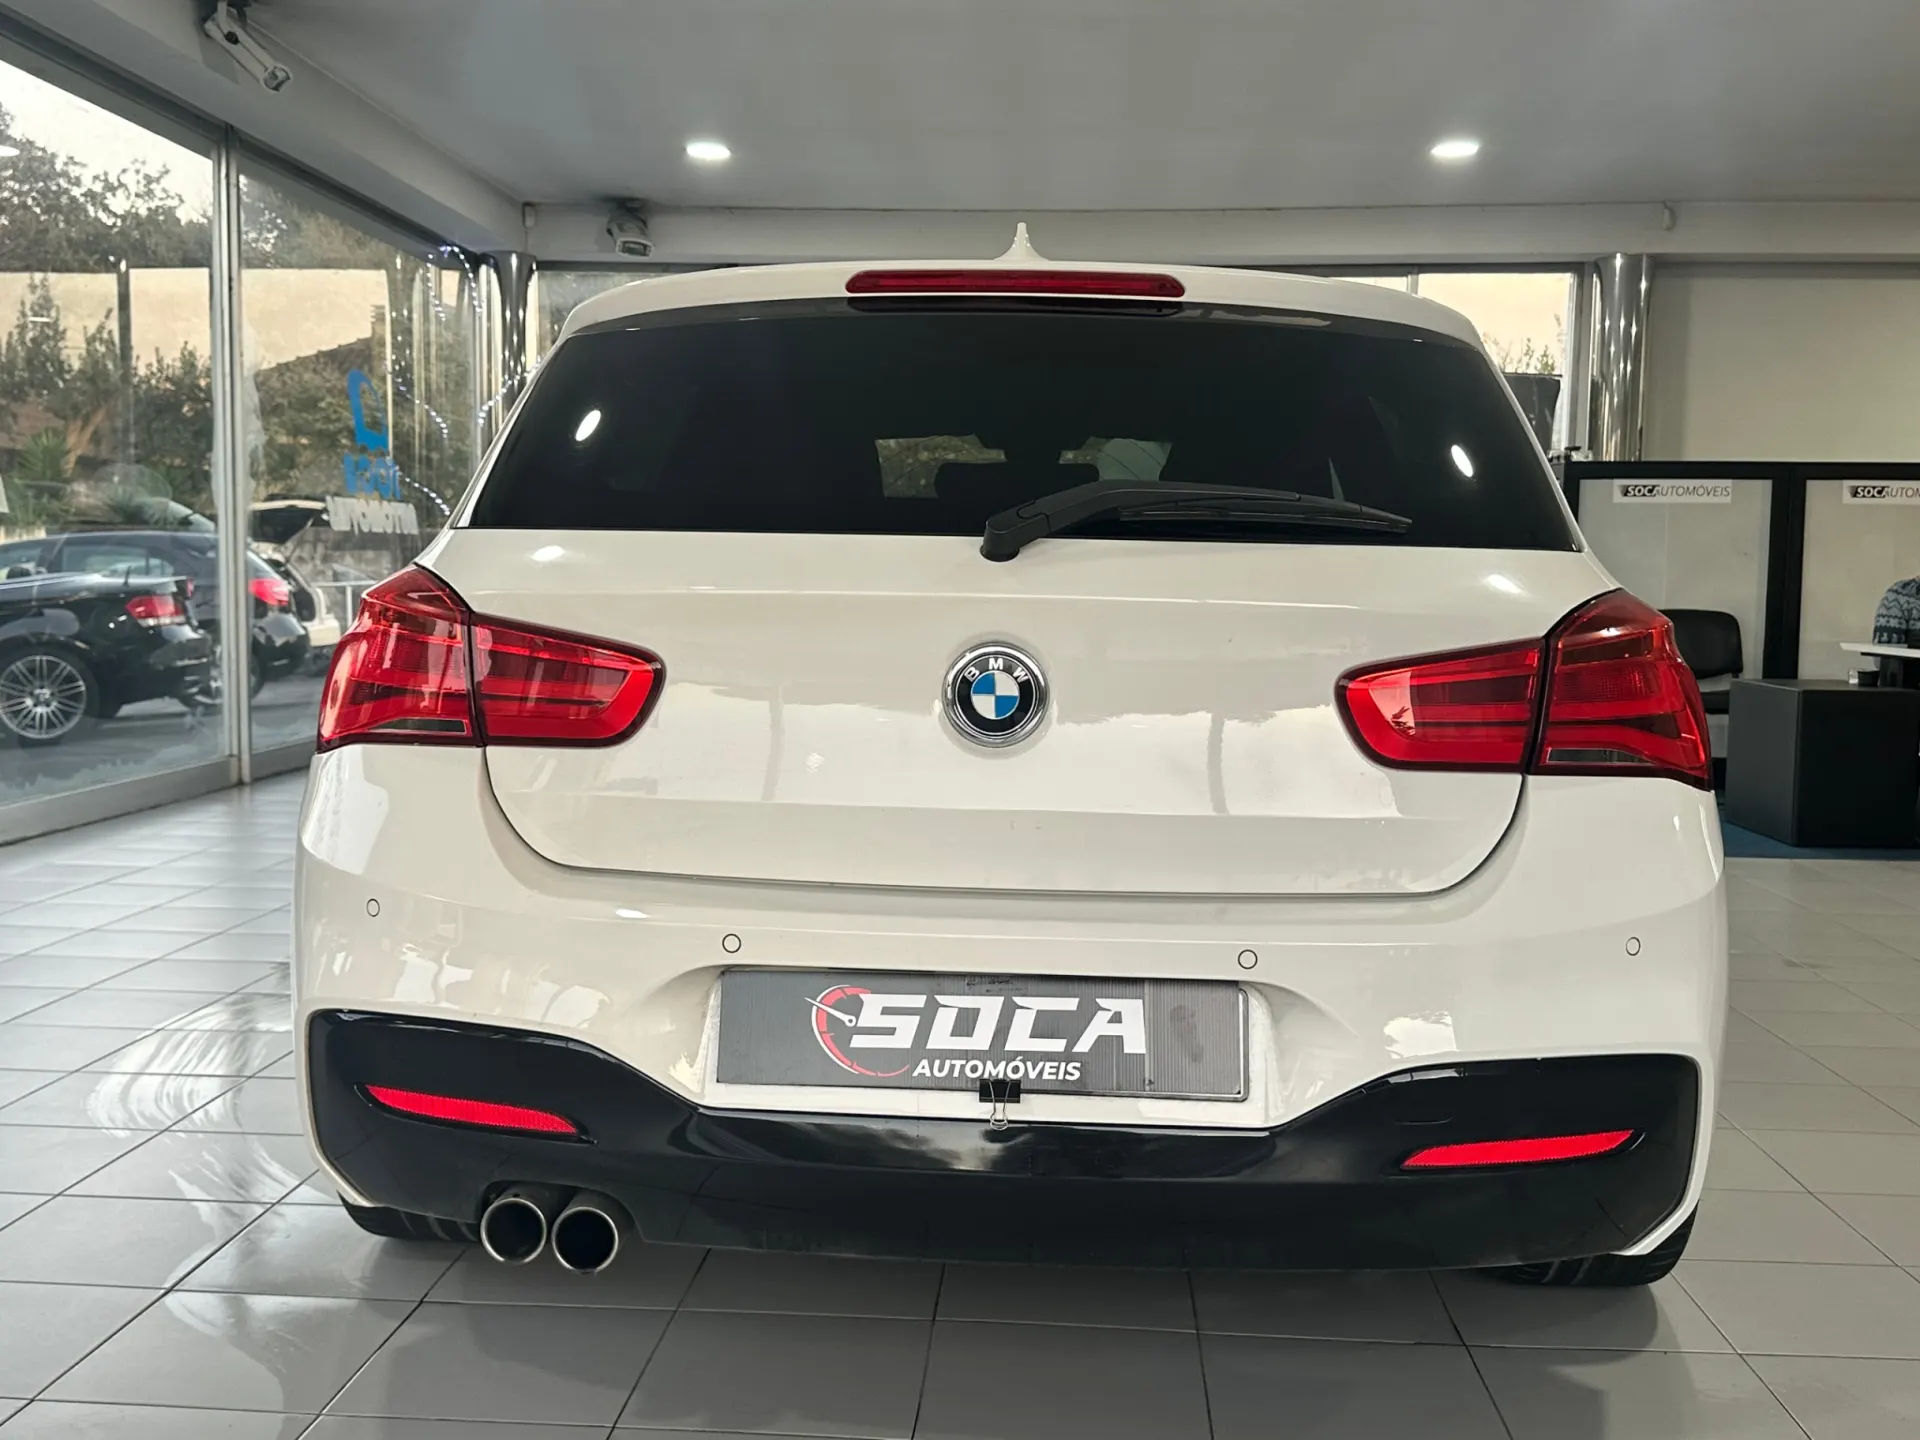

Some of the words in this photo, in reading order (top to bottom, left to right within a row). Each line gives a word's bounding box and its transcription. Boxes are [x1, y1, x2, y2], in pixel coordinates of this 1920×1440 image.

[964, 657, 1029, 682] BMW
[850, 993, 1147, 1054] SOCA
[912, 1056, 1081, 1081] AUTOMÓVEIS
